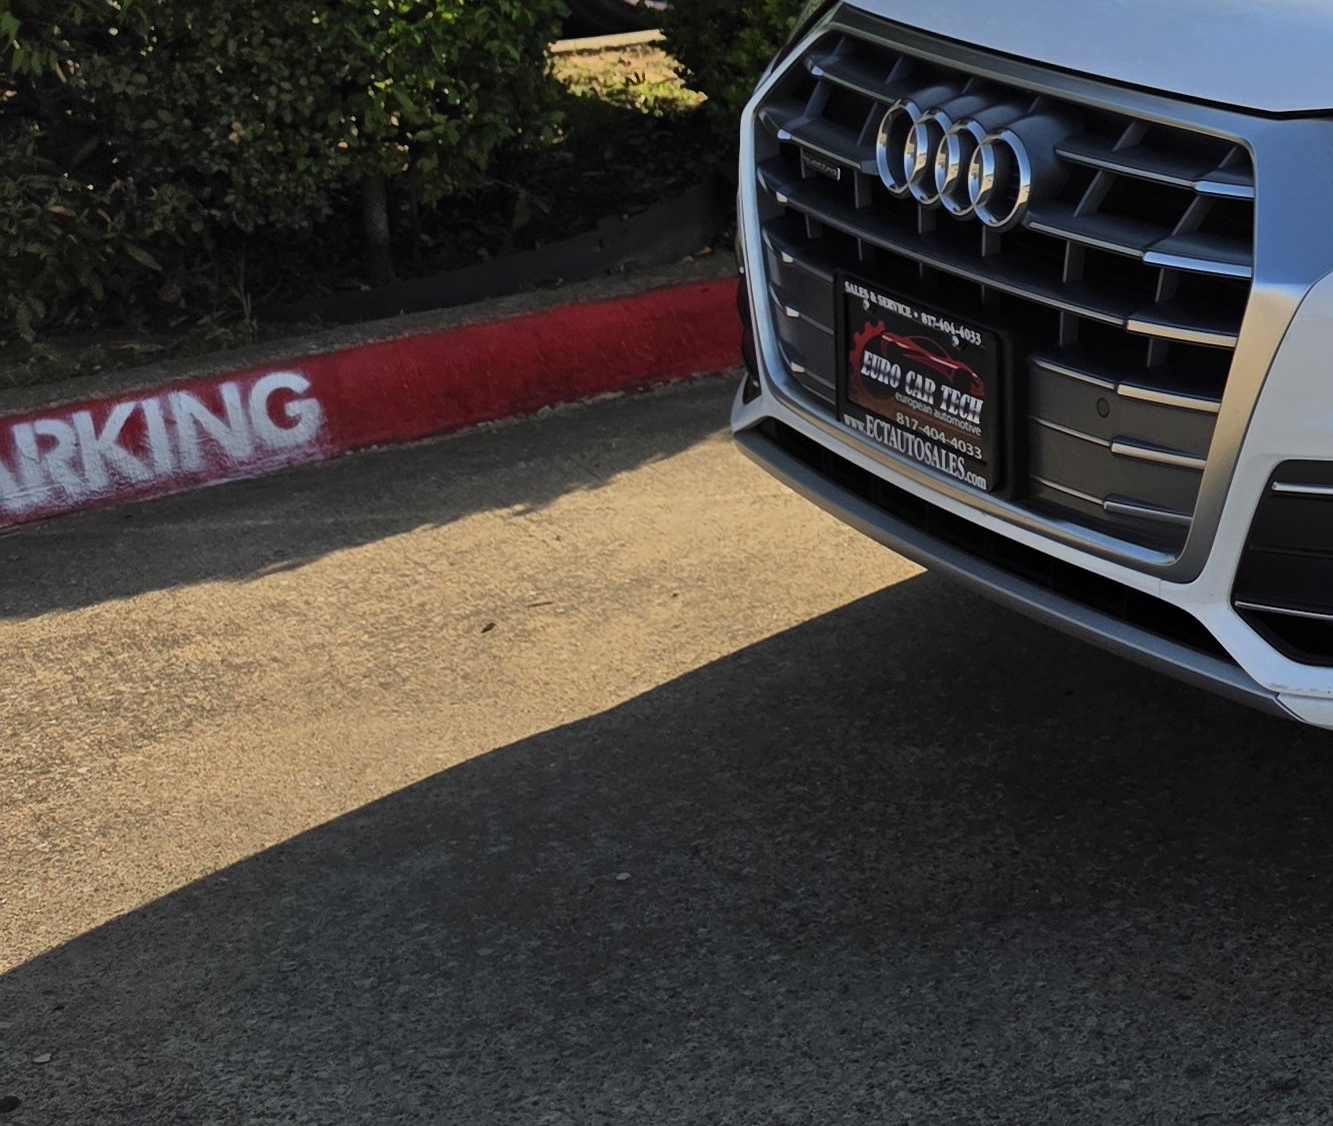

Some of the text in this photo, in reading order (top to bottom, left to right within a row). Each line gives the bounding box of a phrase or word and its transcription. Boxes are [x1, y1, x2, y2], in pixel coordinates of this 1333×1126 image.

[844, 281, 982, 345] SALES & SERVICE 817-404-4033
[860, 350, 984, 424] EURO CAR TECH
[895, 391, 982, 436] european automotive
[843, 414, 986, 490] www.ECTAUTOSALES.com
[896, 412, 983, 459] 817-404-4033
